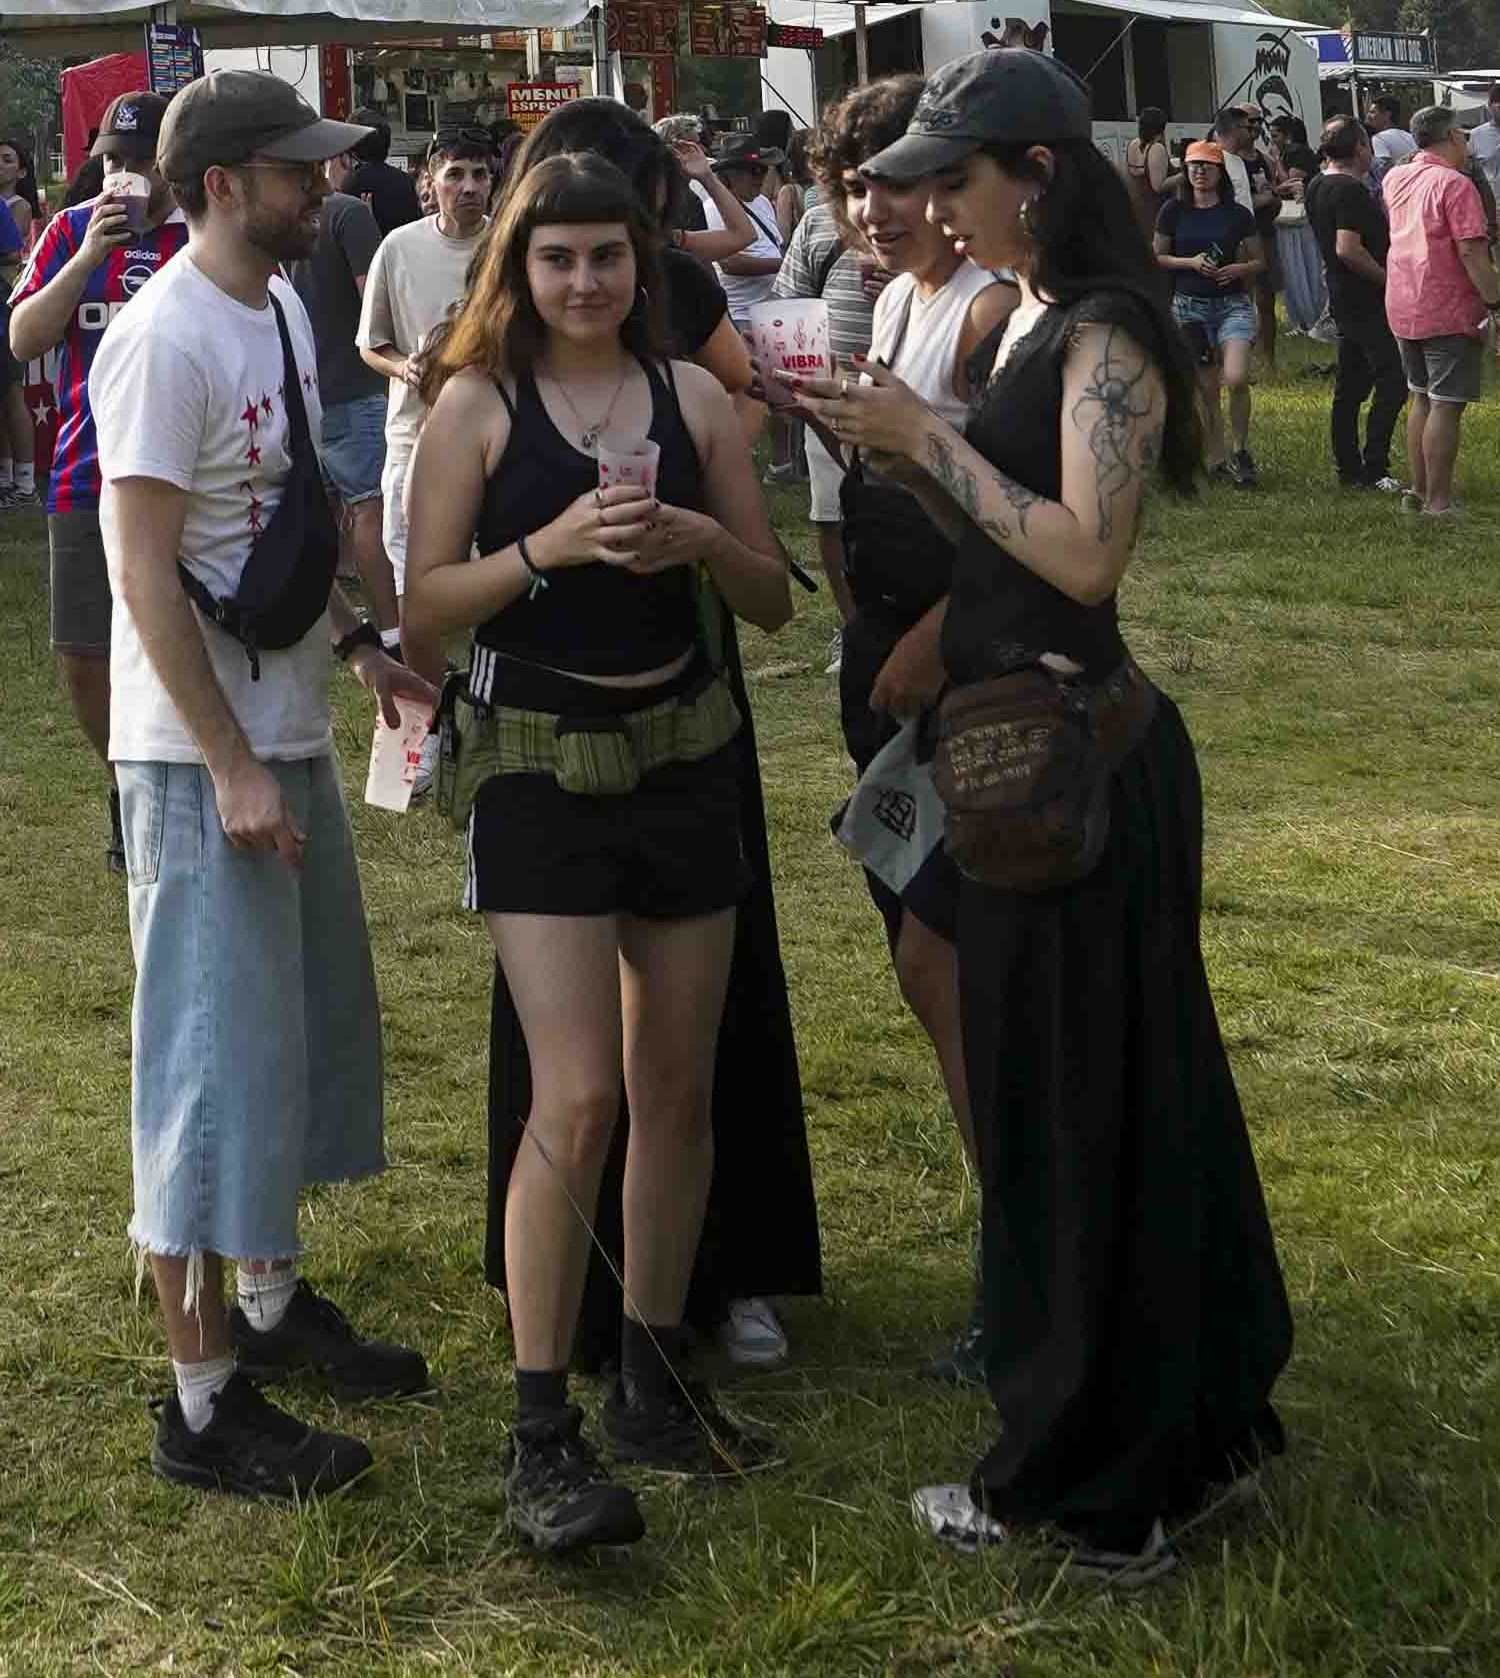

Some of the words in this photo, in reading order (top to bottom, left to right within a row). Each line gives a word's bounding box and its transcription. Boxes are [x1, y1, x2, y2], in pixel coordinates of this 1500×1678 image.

[1357, 35, 1393, 60] AMERICAN
[124, 249, 161, 261] adidas
[782, 354, 825, 369] VIBRA
